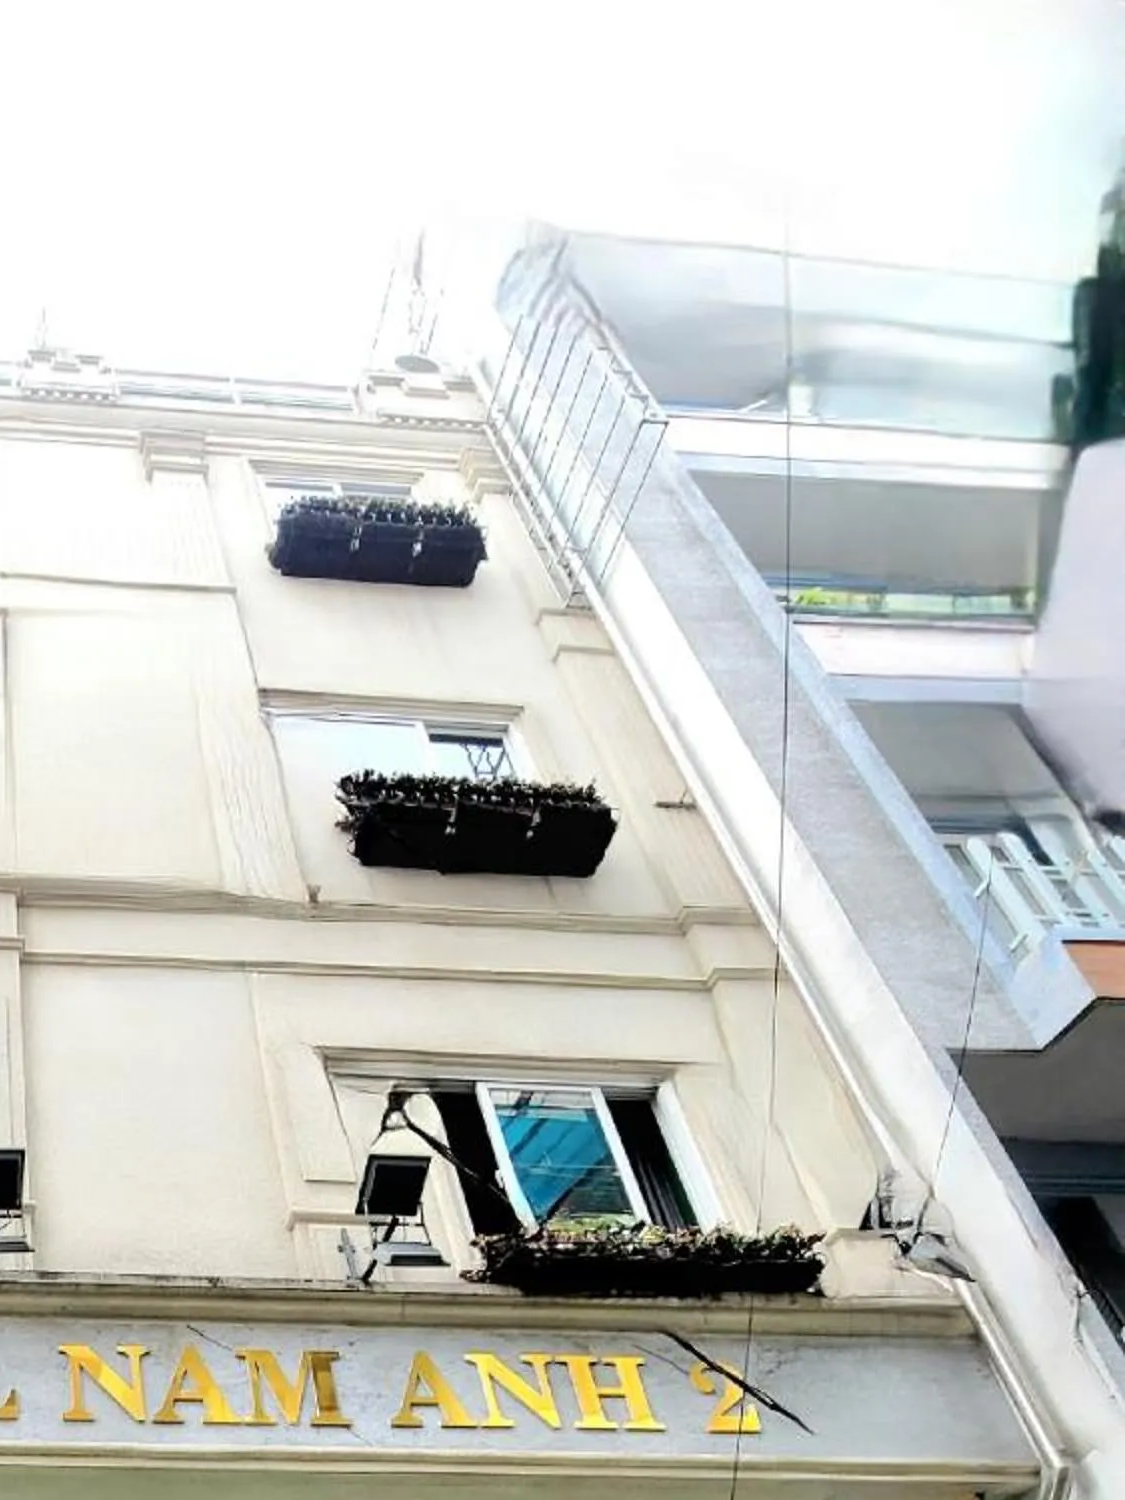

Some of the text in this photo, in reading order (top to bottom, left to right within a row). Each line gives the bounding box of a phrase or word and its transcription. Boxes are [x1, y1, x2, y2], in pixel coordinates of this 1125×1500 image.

[57, 1343, 350, 1427] NAM
[391, 1350, 667, 1433] ANH
[688, 1360, 763, 1434] 2
